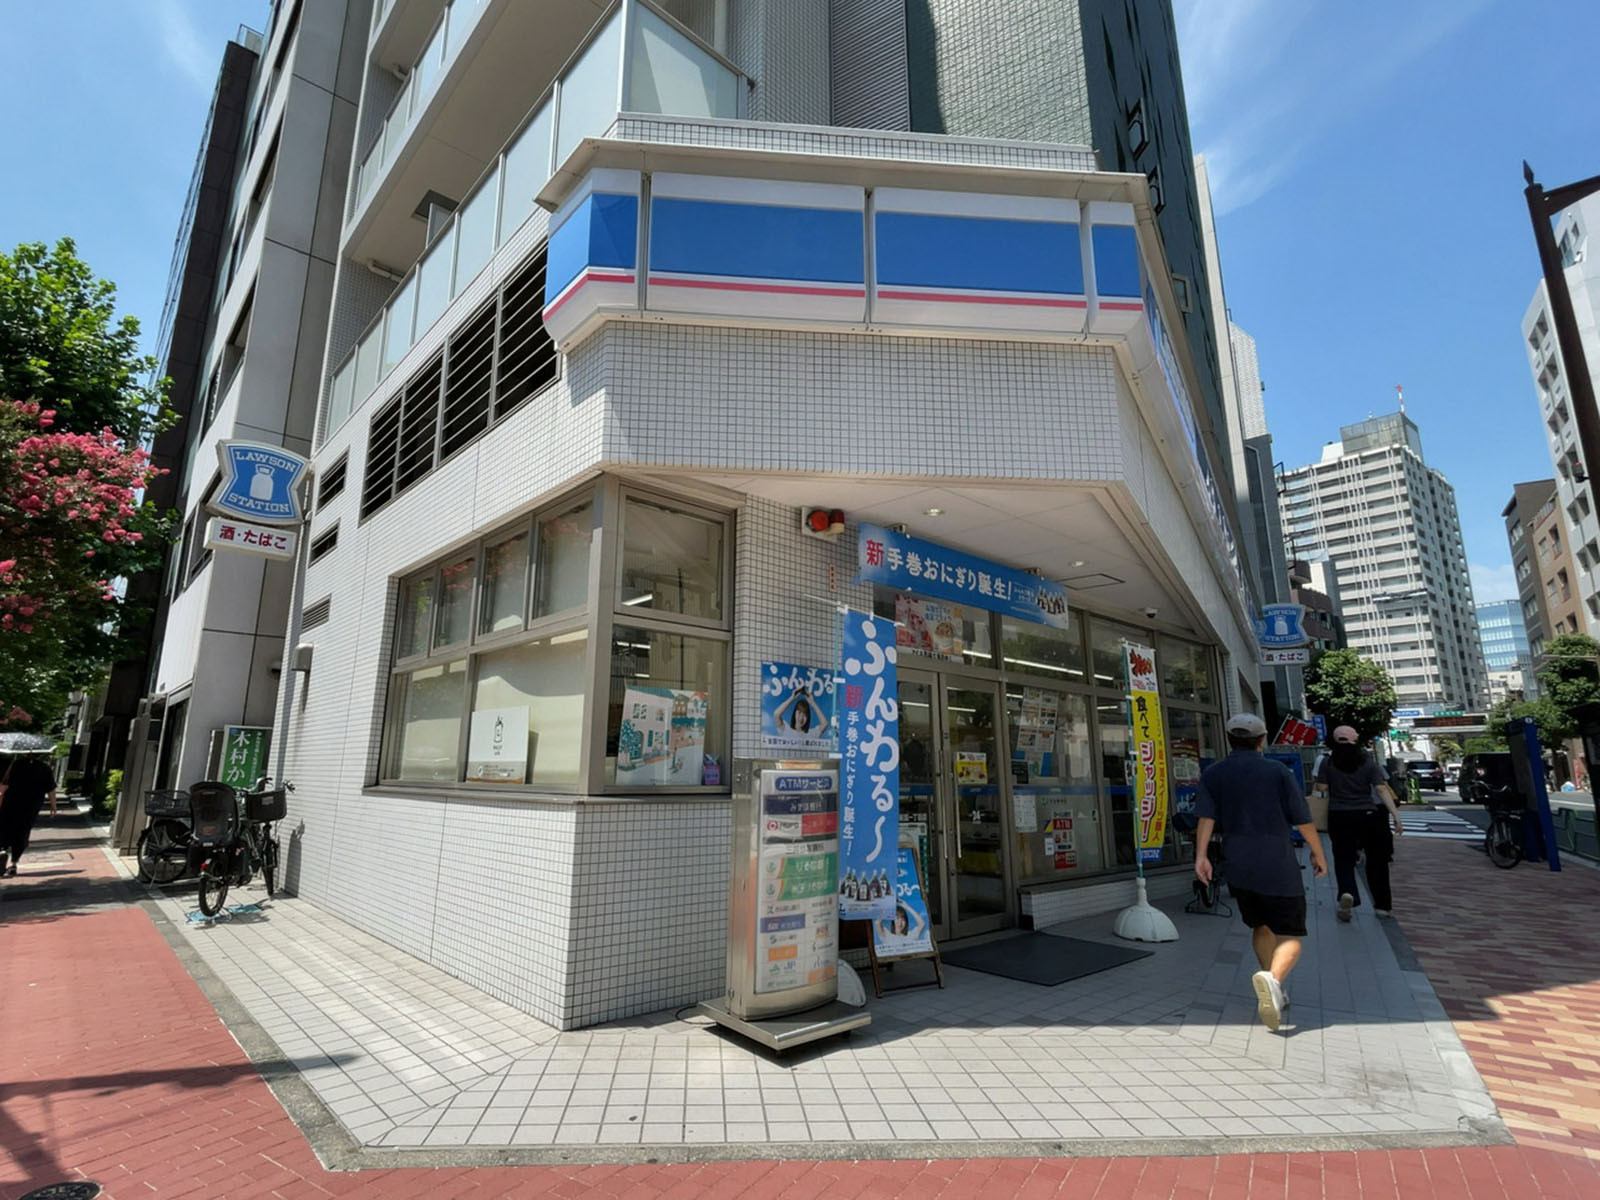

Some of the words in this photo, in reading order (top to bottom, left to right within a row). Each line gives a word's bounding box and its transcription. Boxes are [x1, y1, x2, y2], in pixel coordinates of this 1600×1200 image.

[234, 450, 297, 473] LAWSON
[228, 492, 290, 513] STATION
[219, 524, 288, 550] 酒・たばこ
[779, 778, 831, 791] ATMサービス
